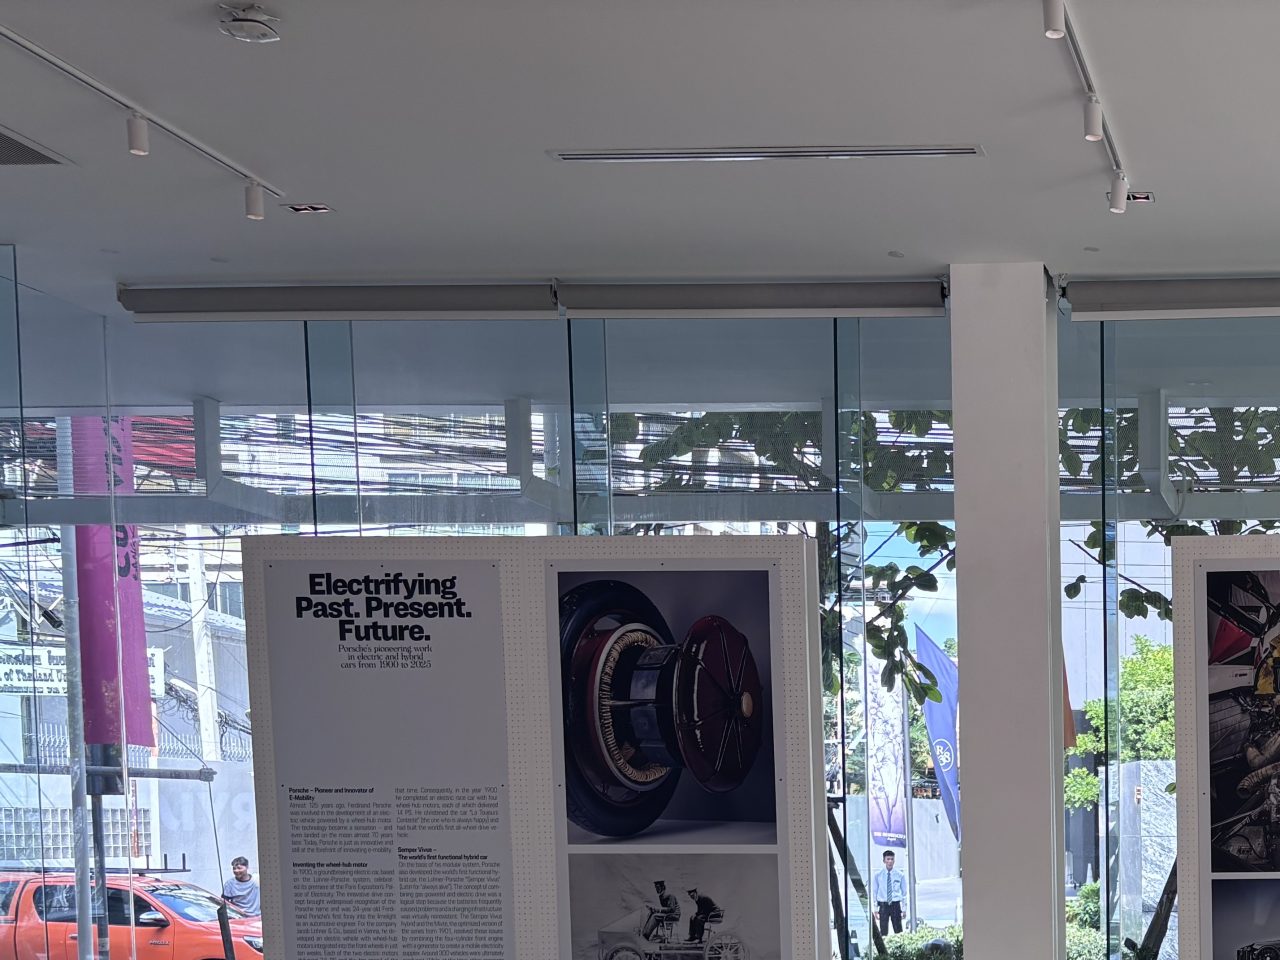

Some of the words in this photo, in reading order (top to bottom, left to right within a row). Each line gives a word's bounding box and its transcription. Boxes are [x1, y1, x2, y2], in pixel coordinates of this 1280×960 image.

[309, 572, 457, 598] Electrifying
[296, 597, 359, 618] Past.
[366, 596, 472, 618] Present.
[339, 620, 431, 641] Future.
[338, 644, 372, 653] Porsche's
[374, 645, 412, 655] pioneering
[413, 644, 432, 653] work
[348, 652, 355, 660] in
[357, 652, 383, 661] electric
[385, 652, 399, 661] and
[401, 652, 424, 663] hybrid
[358, 660, 376, 668] from
[380, 660, 399, 668] 1900
[401, 660, 408, 669] to
[410, 660, 432, 668] 2025
